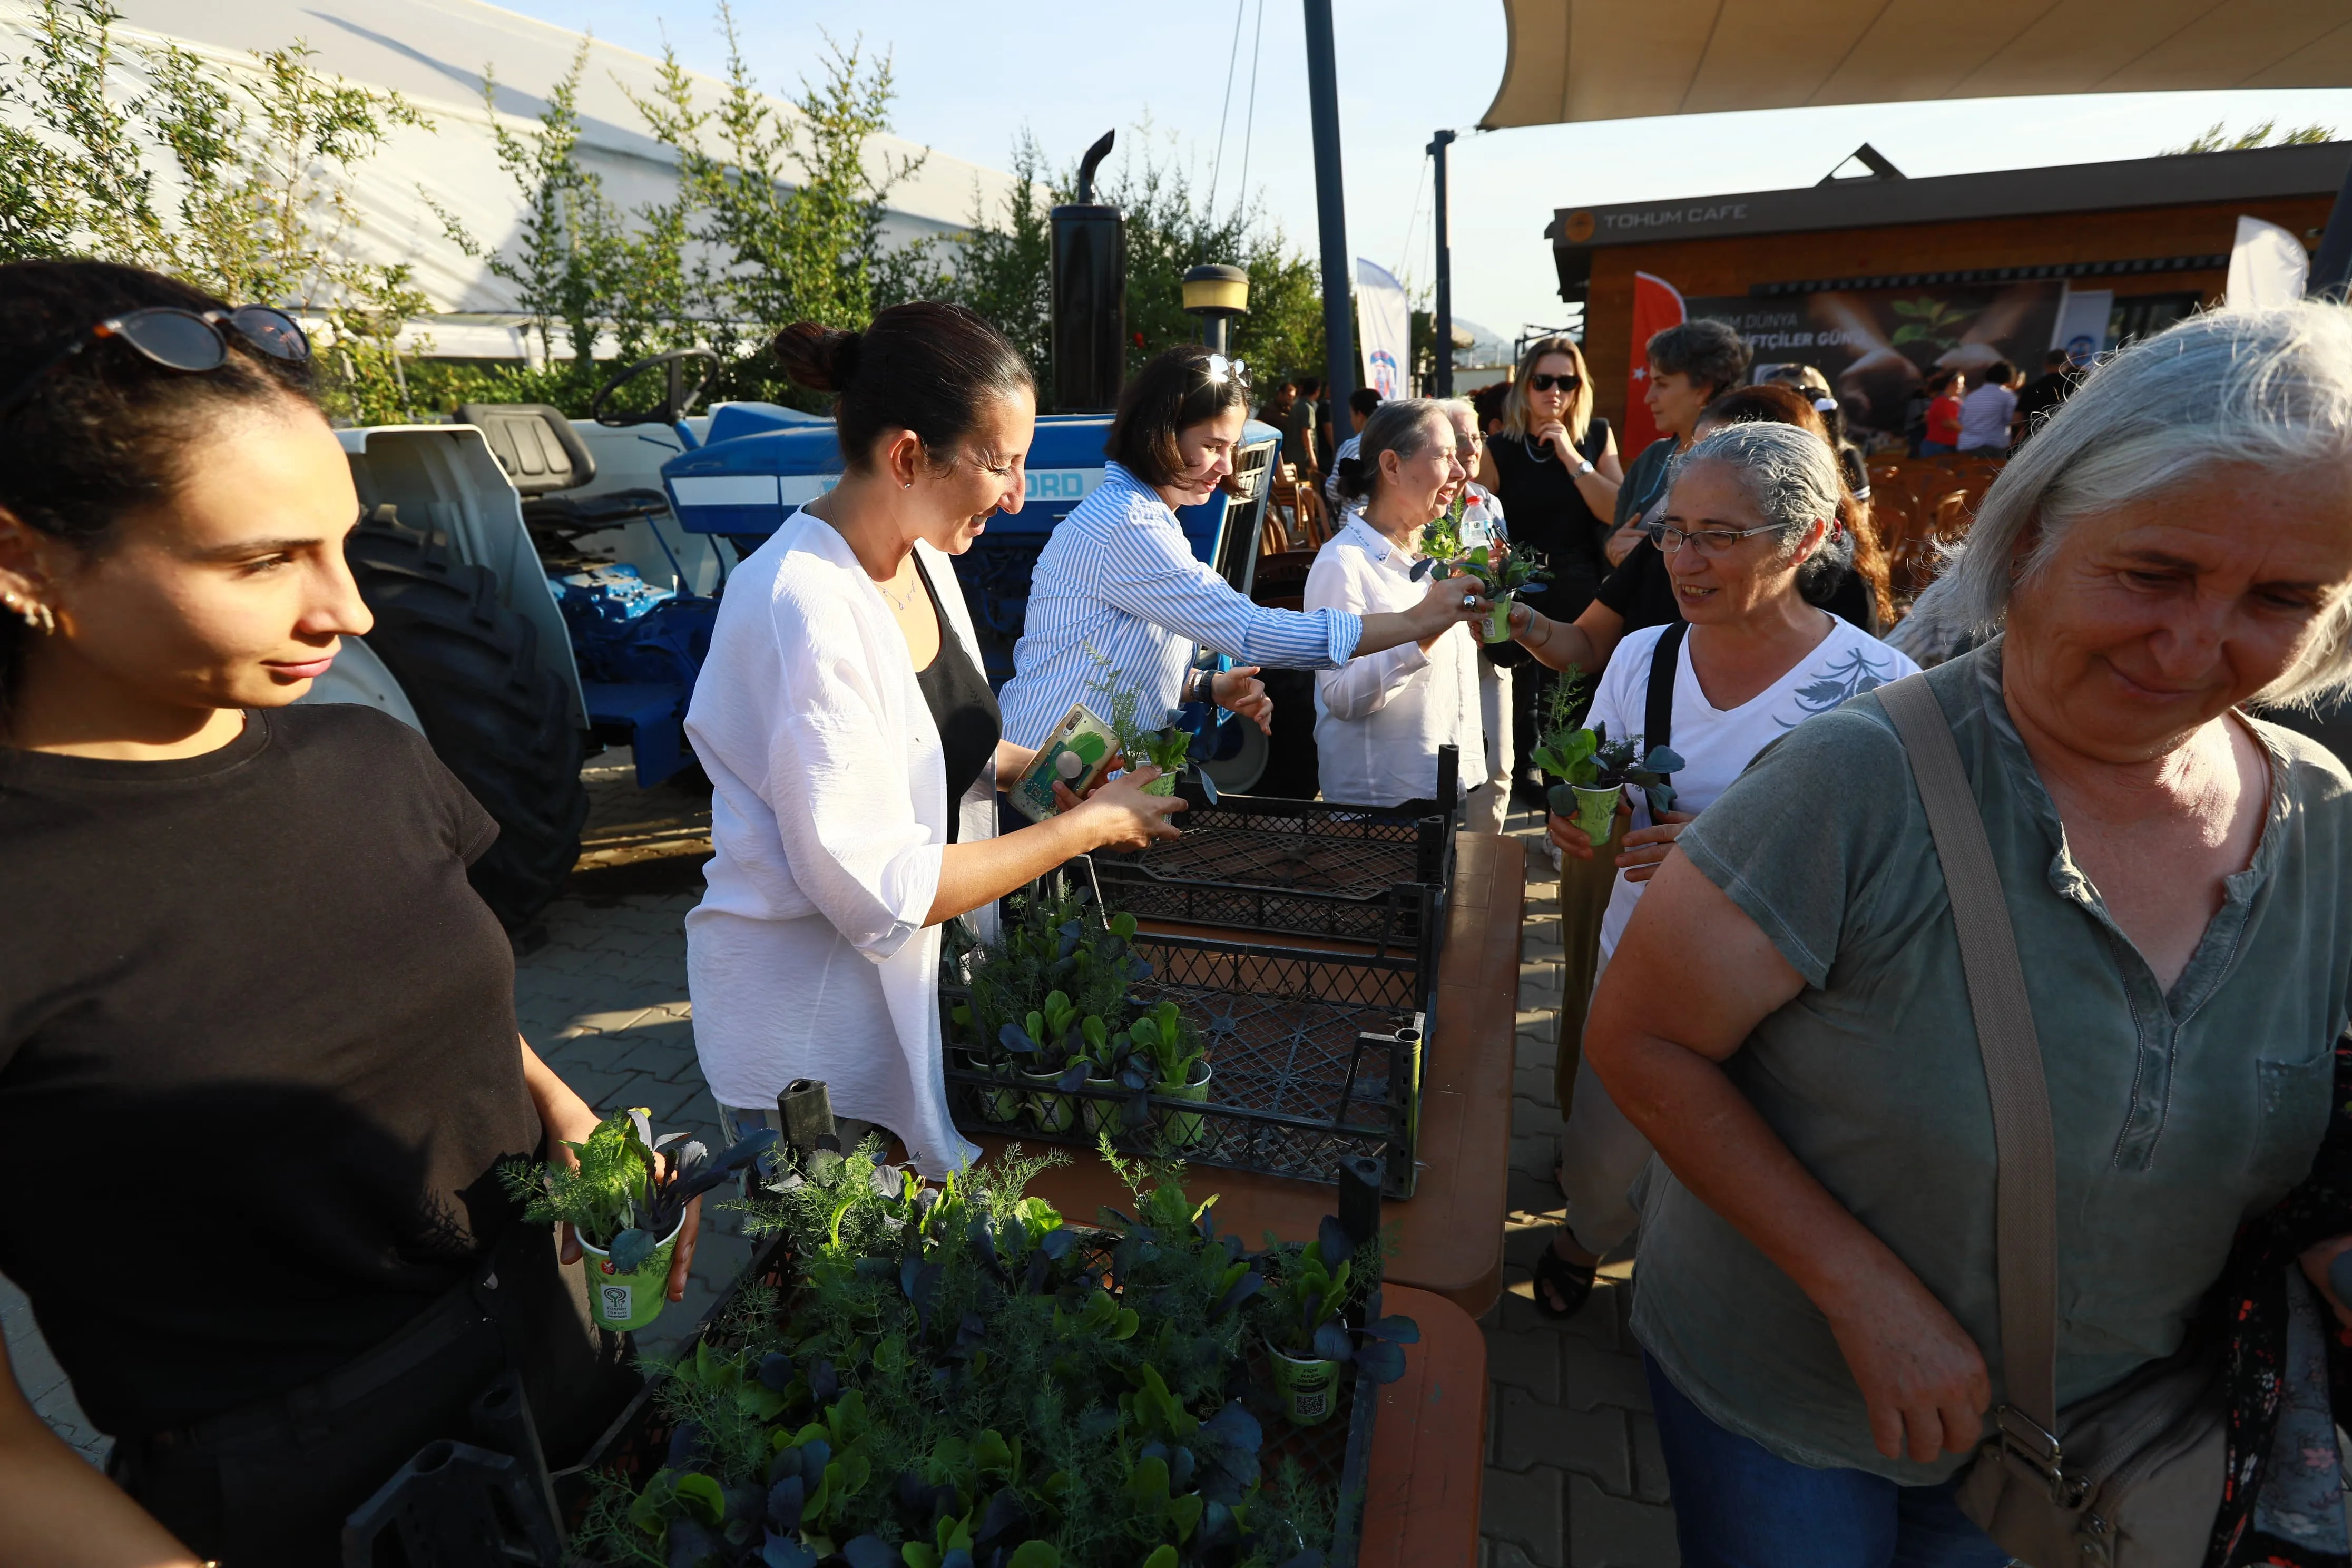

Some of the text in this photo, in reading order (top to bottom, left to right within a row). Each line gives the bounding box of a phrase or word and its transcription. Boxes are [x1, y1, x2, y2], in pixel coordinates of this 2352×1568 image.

[1604, 204, 1748, 228] TOHUM CAFE
[1745, 311, 1798, 329] DÜNYA
[1739, 330, 1814, 351] İFTÇİLER
